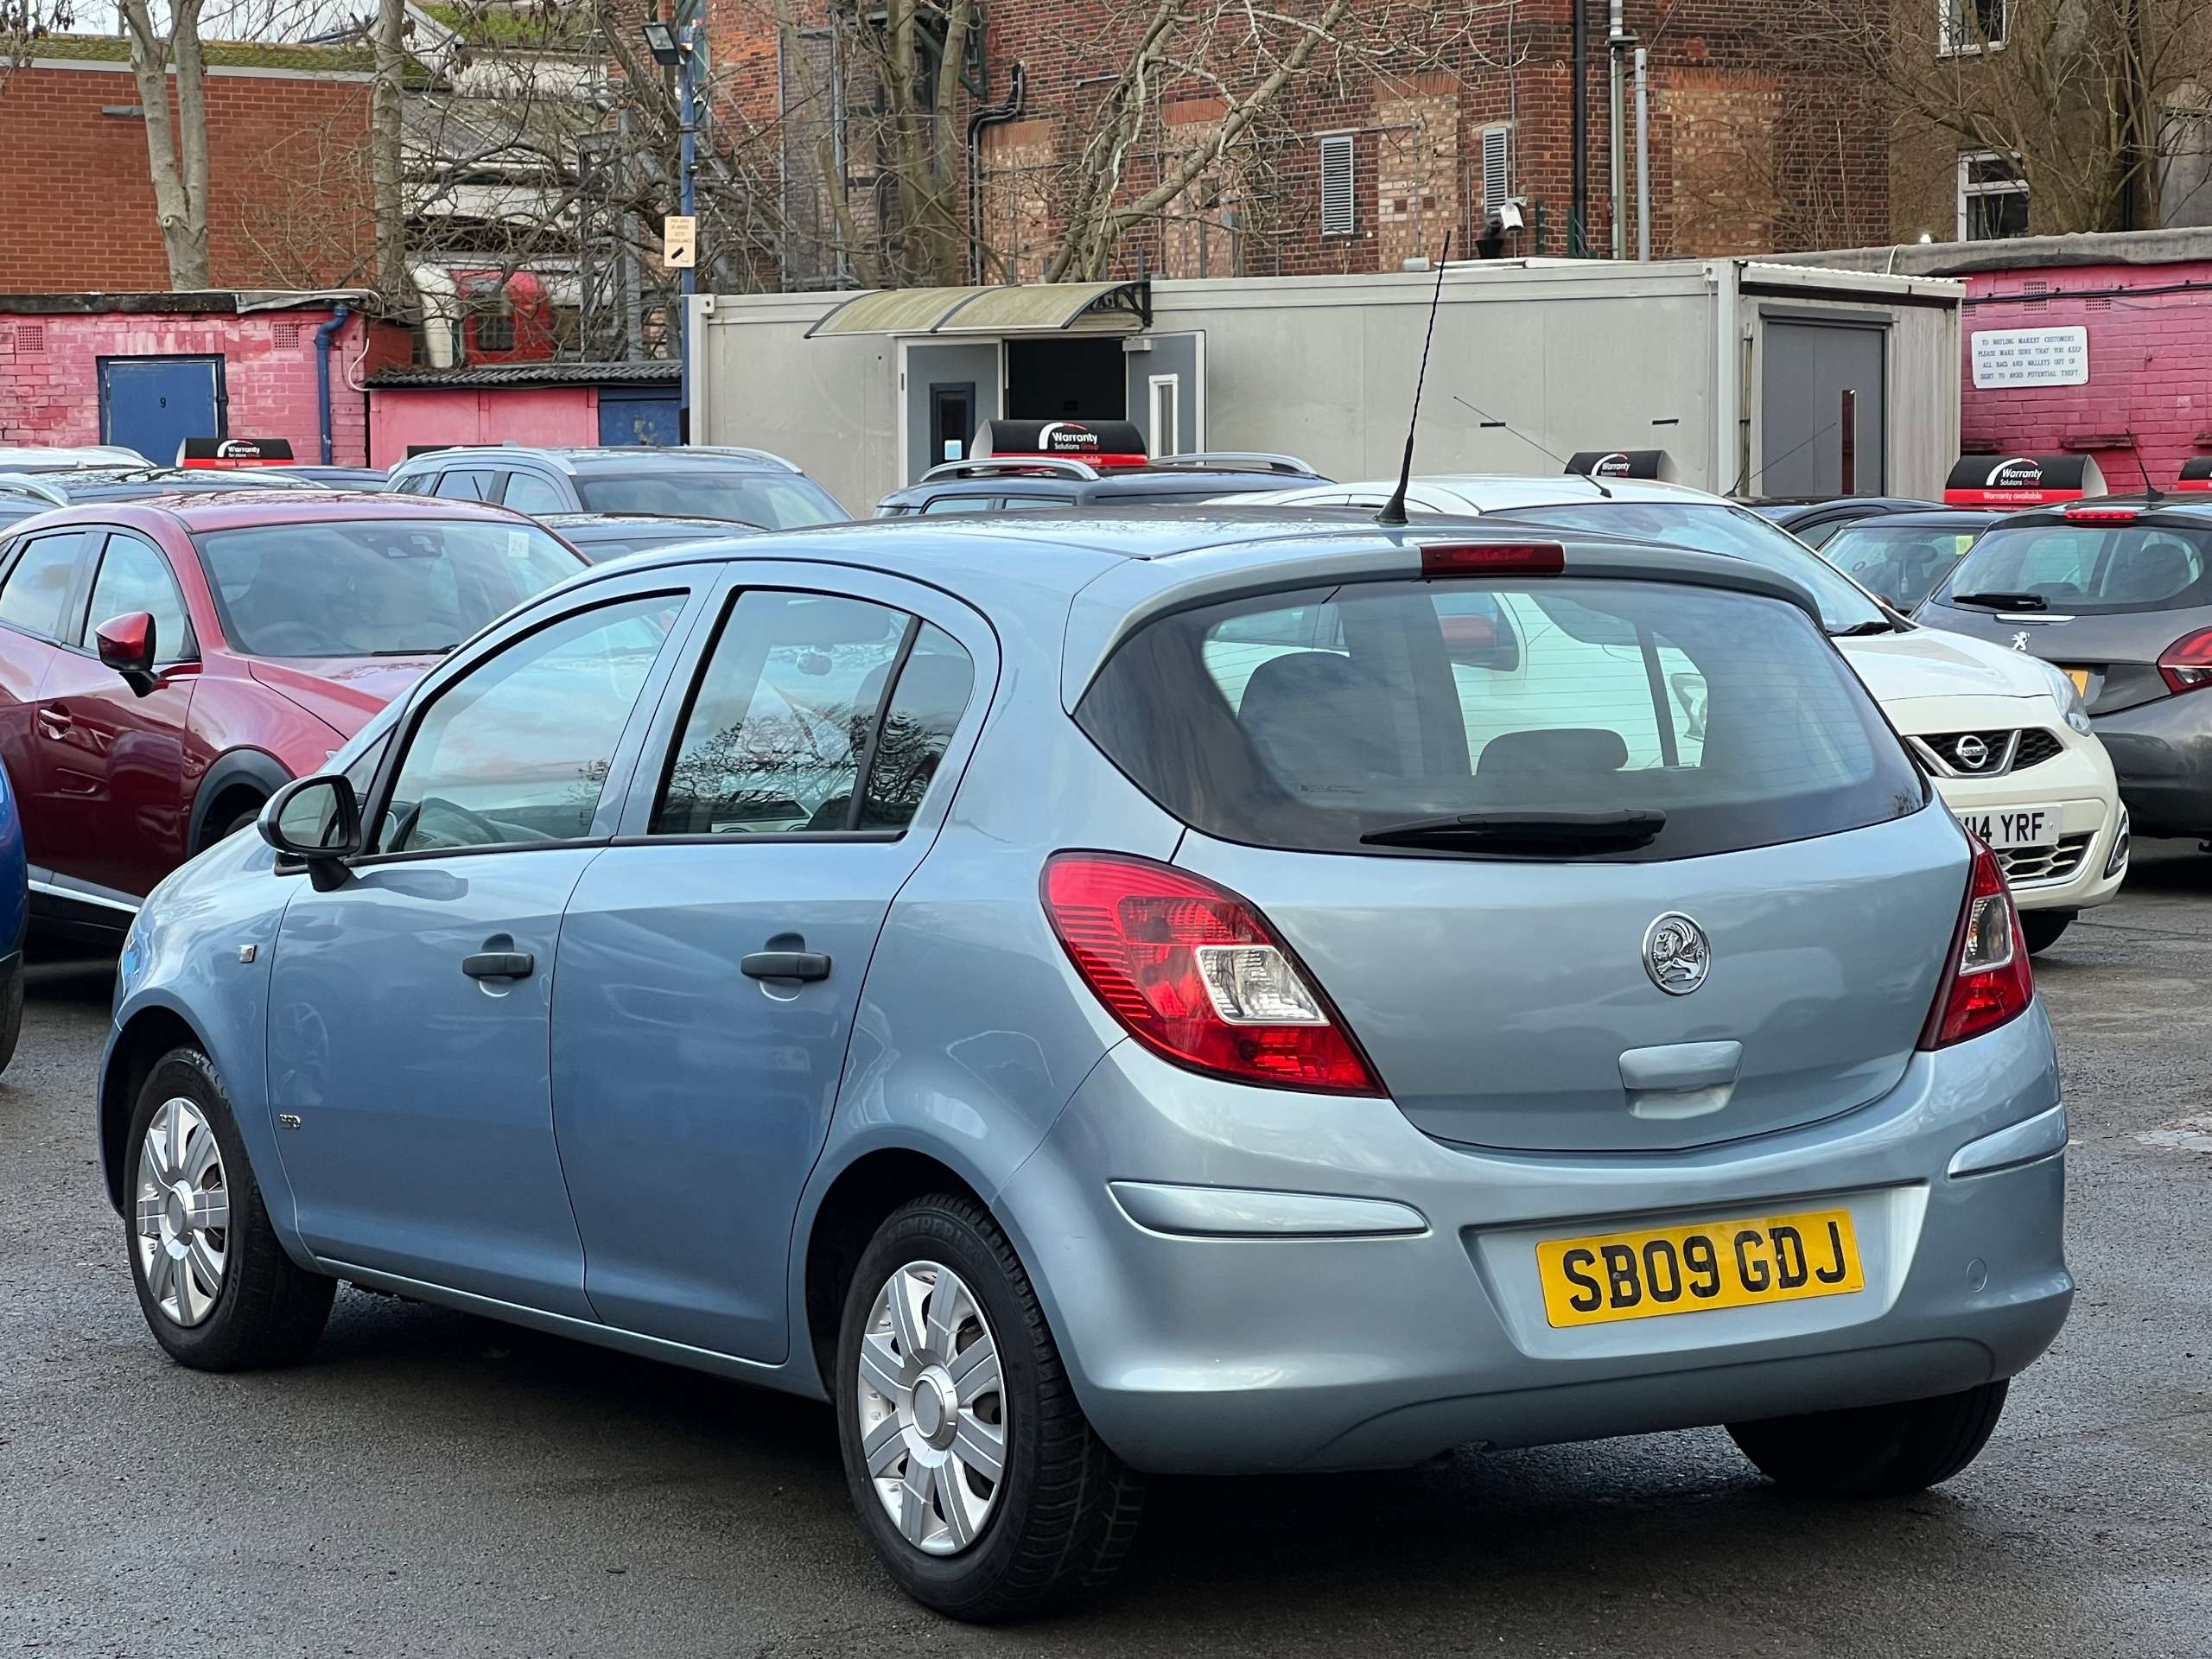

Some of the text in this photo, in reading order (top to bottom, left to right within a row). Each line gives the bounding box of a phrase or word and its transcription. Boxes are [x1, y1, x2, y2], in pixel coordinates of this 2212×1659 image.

[160, 397, 166, 408] 9
[1052, 432, 1097, 444] Warranty
[228, 446, 260, 454] Warranty
[1602, 462, 1630, 472] Warranty
[2002, 468, 2043, 480] Warranty
[1983, 492, 2012, 500] Warranty
[2001, 812, 2044, 842] YRF
[1562, 1220, 1846, 1313] SB09 GDJ
